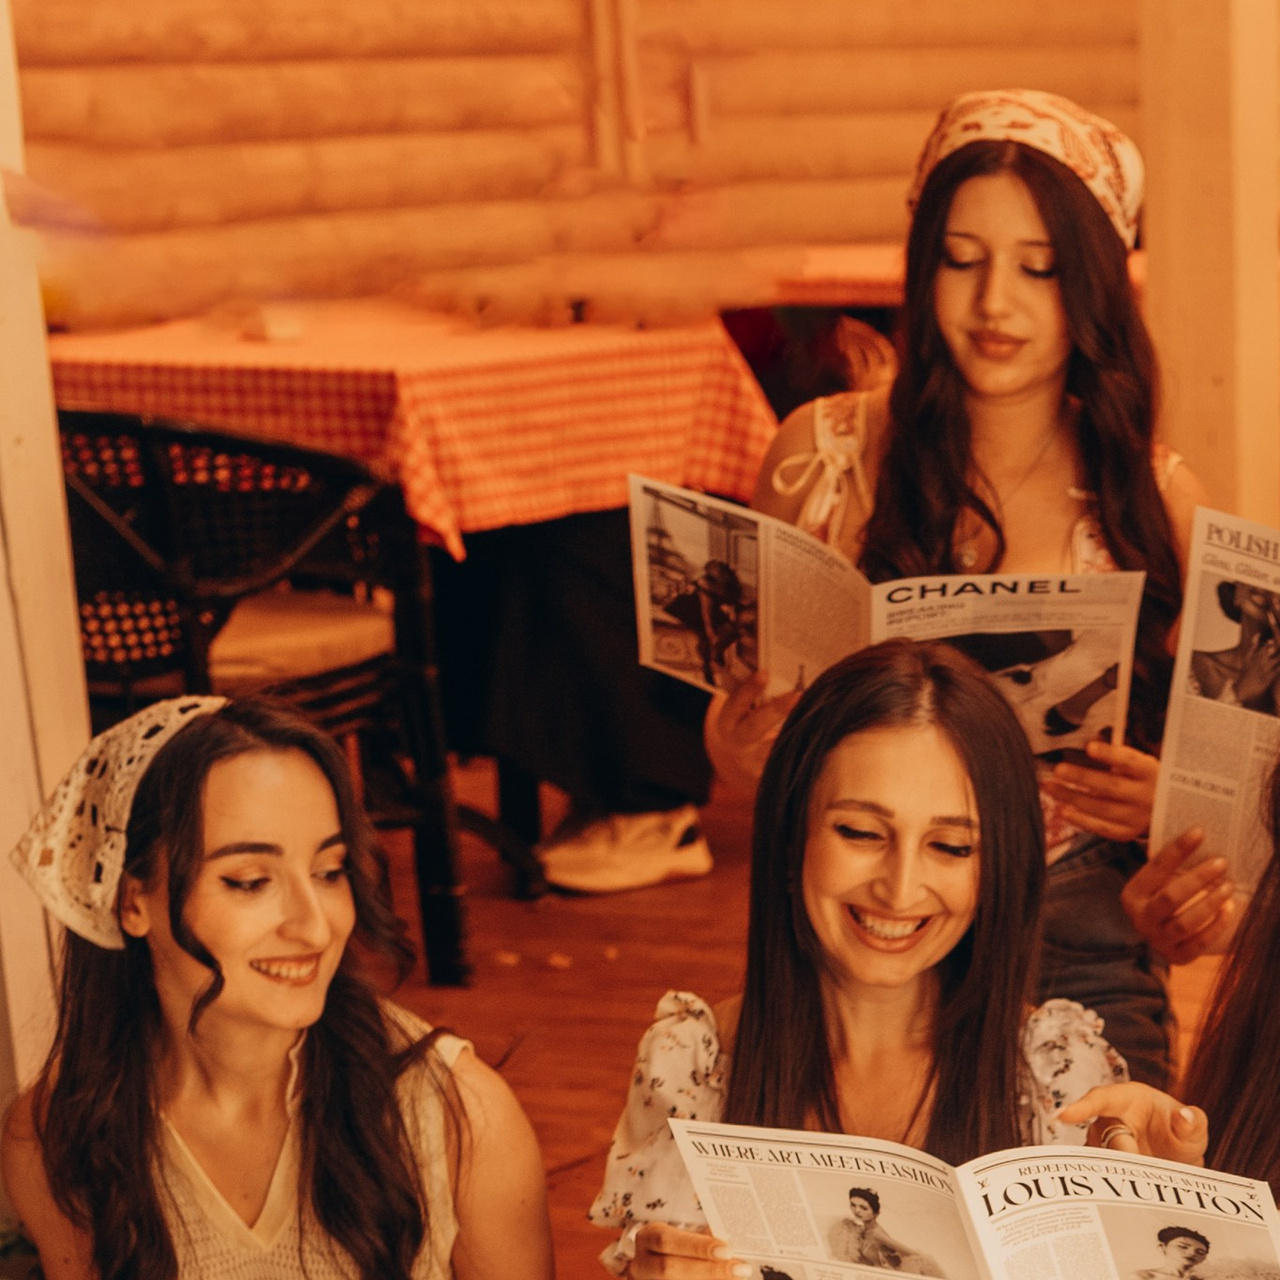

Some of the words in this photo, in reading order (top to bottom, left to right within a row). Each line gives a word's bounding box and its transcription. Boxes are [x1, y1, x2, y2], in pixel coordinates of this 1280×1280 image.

[1206, 523, 1279, 561] POLISH
[886, 580, 1082, 604] CHANEL
[691, 1140, 763, 1162] WHERE
[767, 1149, 804, 1165] ART
[808, 1153, 877, 1173] MEETS
[879, 1157, 956, 1196] FASHION
[1018, 1162, 1103, 1178] REDEFINING
[1105, 1165, 1180, 1186] ELEGANCE
[1182, 1175, 1219, 1193] WITH
[982, 1174, 1094, 1218] LOUIS
[1101, 1176, 1265, 1222] VUITTON
